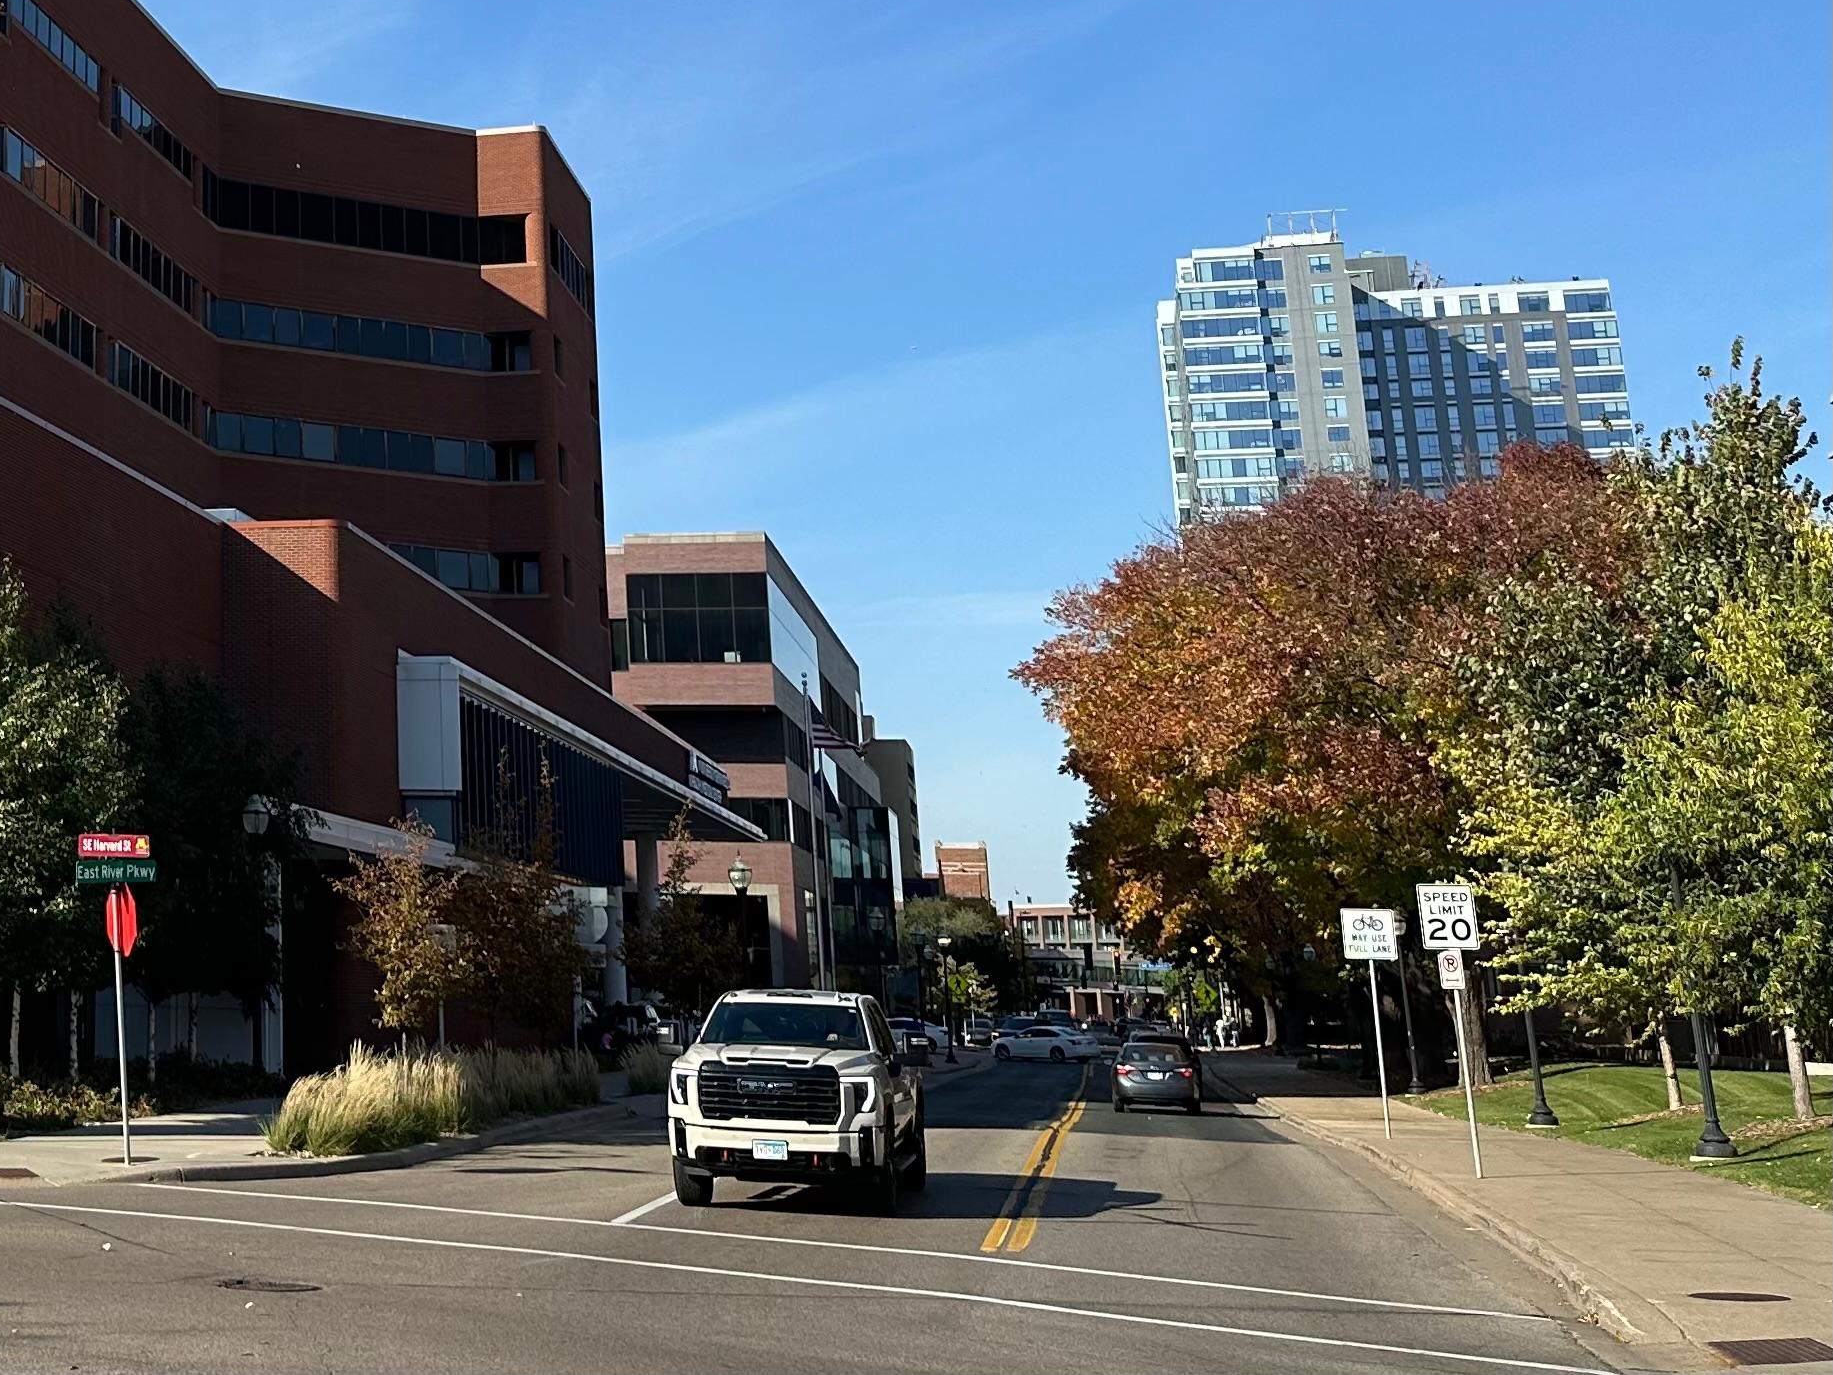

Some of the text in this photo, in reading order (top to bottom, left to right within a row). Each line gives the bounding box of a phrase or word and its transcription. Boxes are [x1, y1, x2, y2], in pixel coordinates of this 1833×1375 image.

[83, 838, 93, 851] SE
[93, 839, 123, 852] Harvard
[123, 839, 132, 852] St
[77, 864, 156, 882] East River Pkwy
[1423, 892, 1468, 902] SPEED
[1429, 905, 1464, 915] LIMIT
[1427, 918, 1471, 941] 20
[1351, 934, 1387, 943] MAY USE
[1372, 944, 1391, 953] LANE
